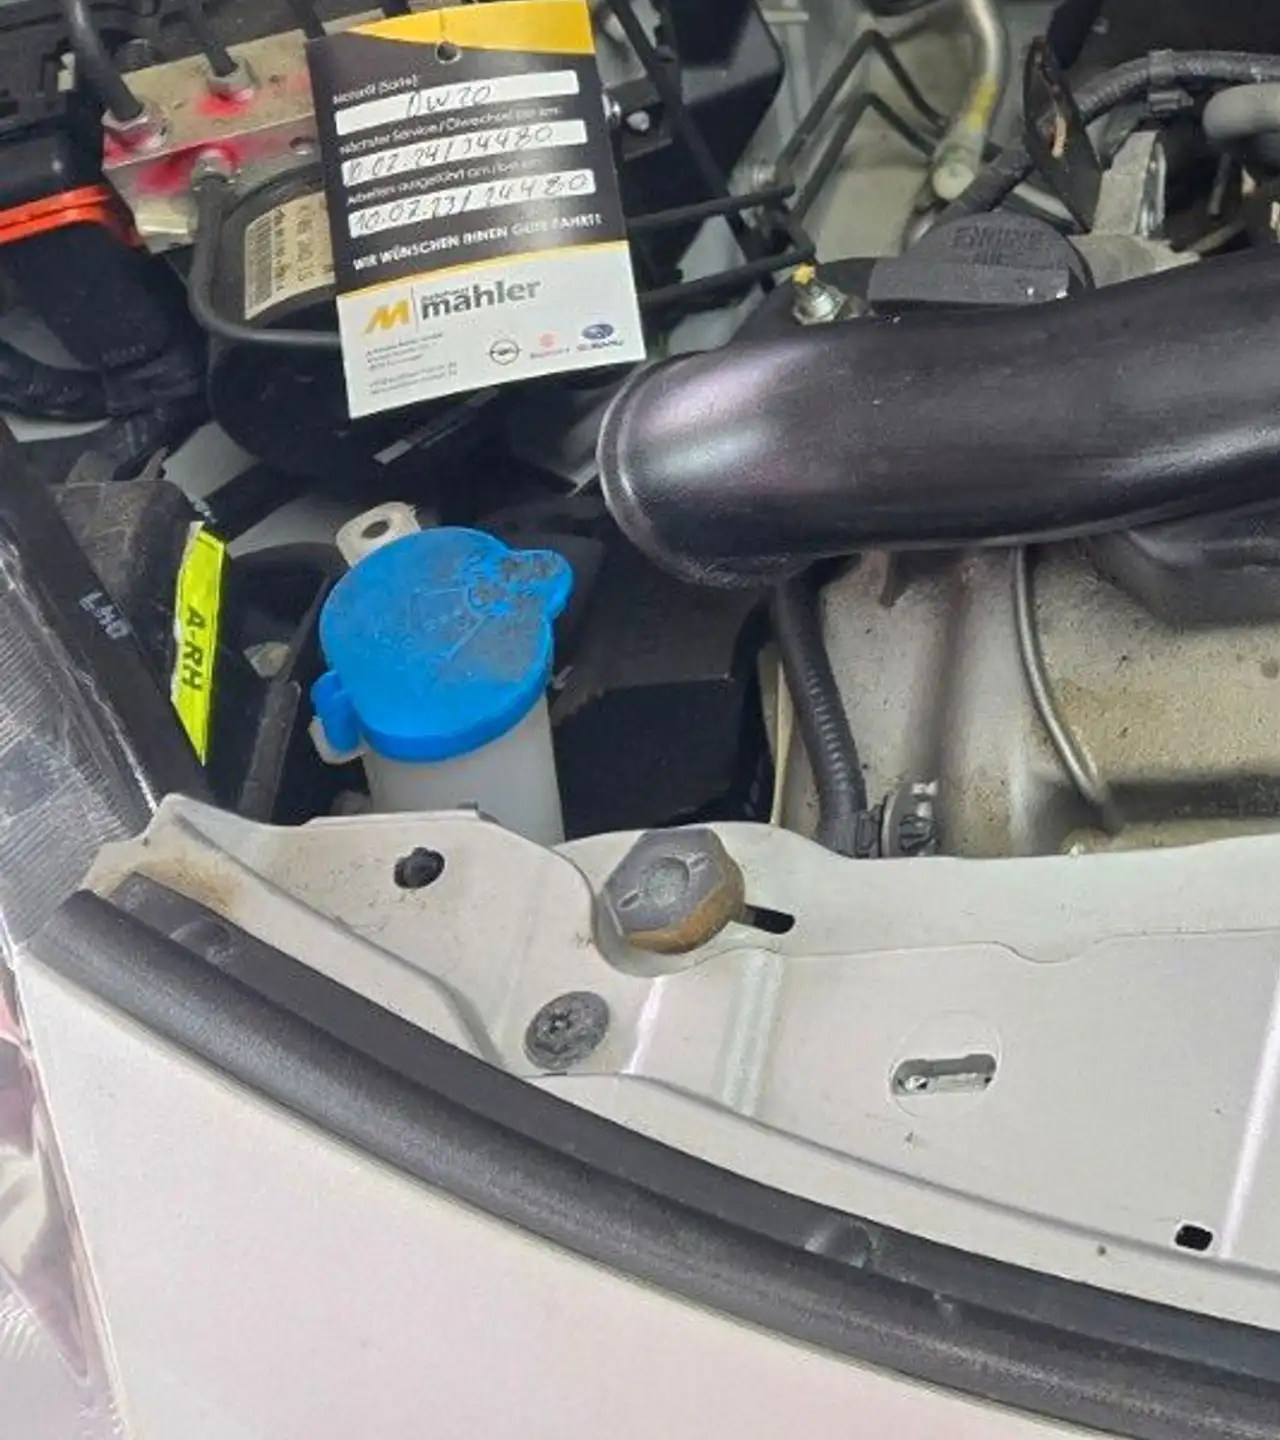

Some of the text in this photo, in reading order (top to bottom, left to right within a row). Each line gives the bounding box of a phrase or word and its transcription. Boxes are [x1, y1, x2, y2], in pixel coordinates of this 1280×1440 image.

[338, 134, 390, 155] Nächster
[391, 122, 438, 143] Service
[346, 185, 397, 206] Arbeiten
[398, 169, 465, 192] ausgeführt
[352, 254, 378, 271] WIR
[379, 235, 460, 264] WÜNSCHEN
[462, 225, 509, 245] IHNEN
[510, 219, 548, 236] GUTE
[181, 603, 207, 692] A-RH
